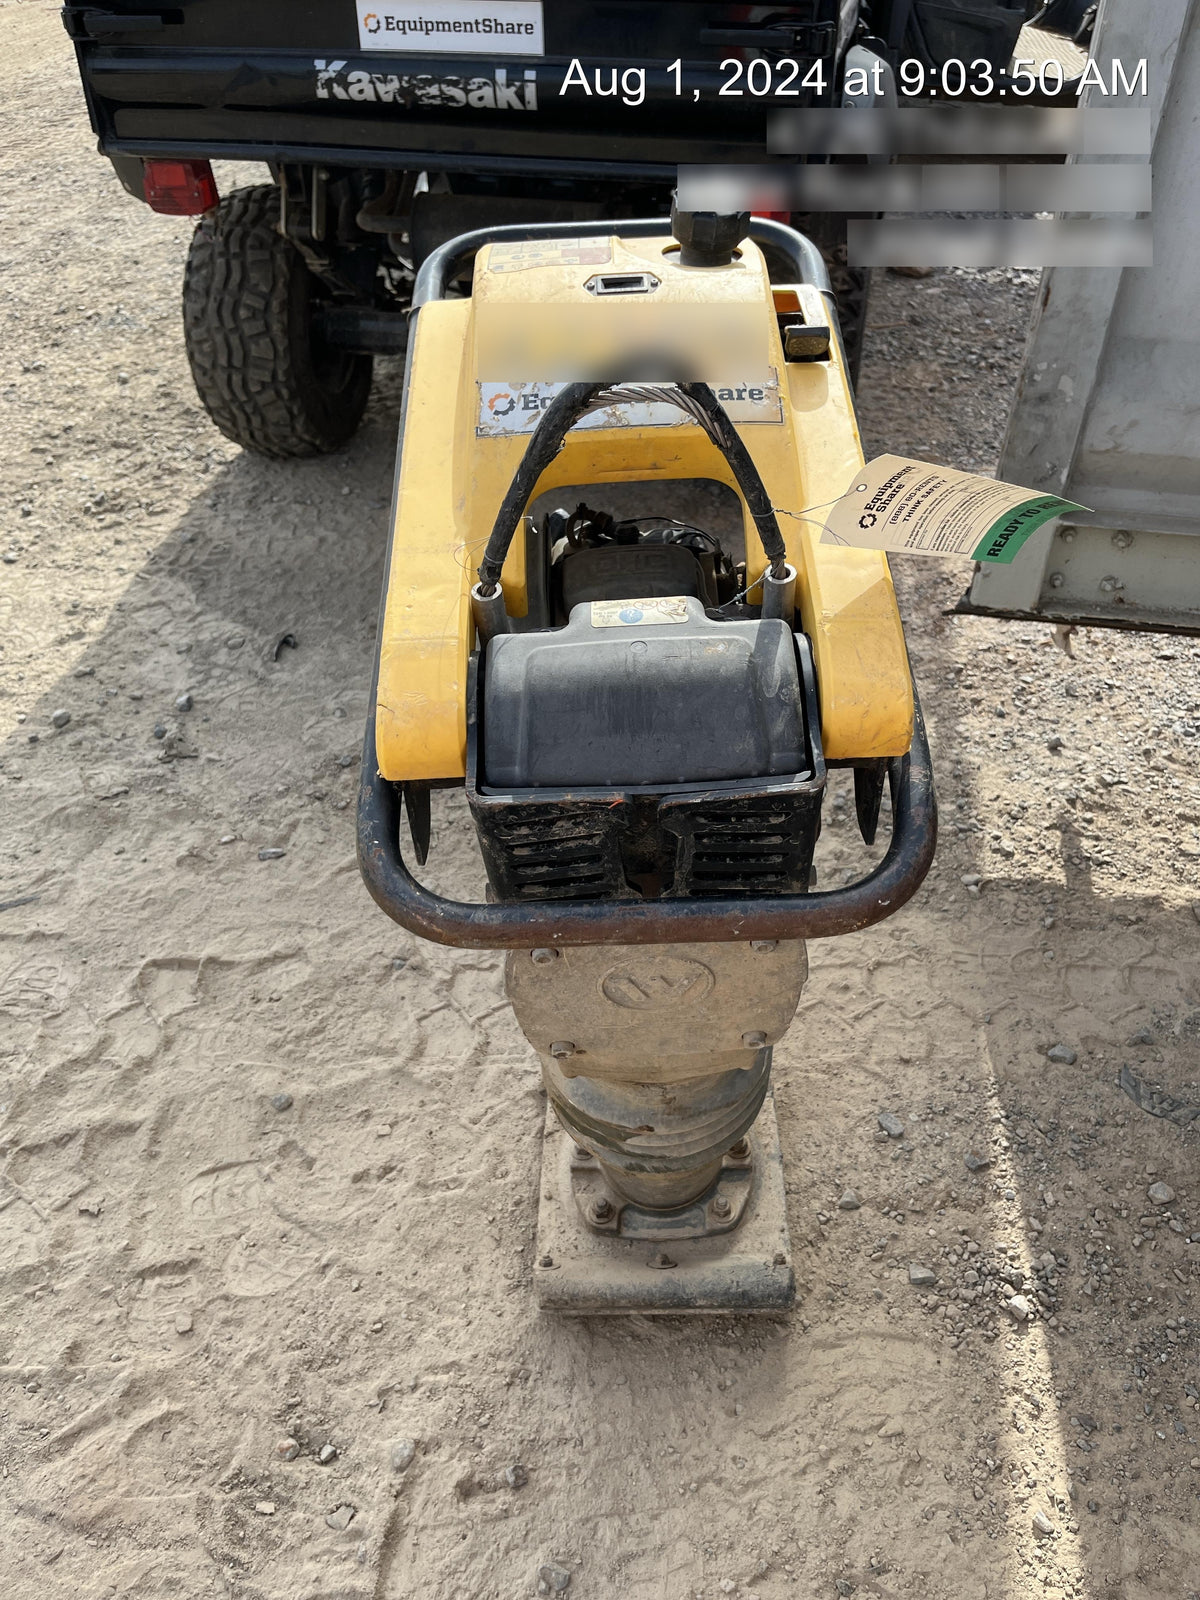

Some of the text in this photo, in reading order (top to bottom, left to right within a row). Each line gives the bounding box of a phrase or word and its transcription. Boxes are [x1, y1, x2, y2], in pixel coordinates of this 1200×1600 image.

[384, 15, 535, 35] EquipmentShare
[864, 466, 916, 511] Equipment
[876, 484, 905, 512] Share
[902, 479, 947, 522] THINK SAFETY
[986, 518, 1025, 557] READY
[1018, 508, 1041, 518] TO
